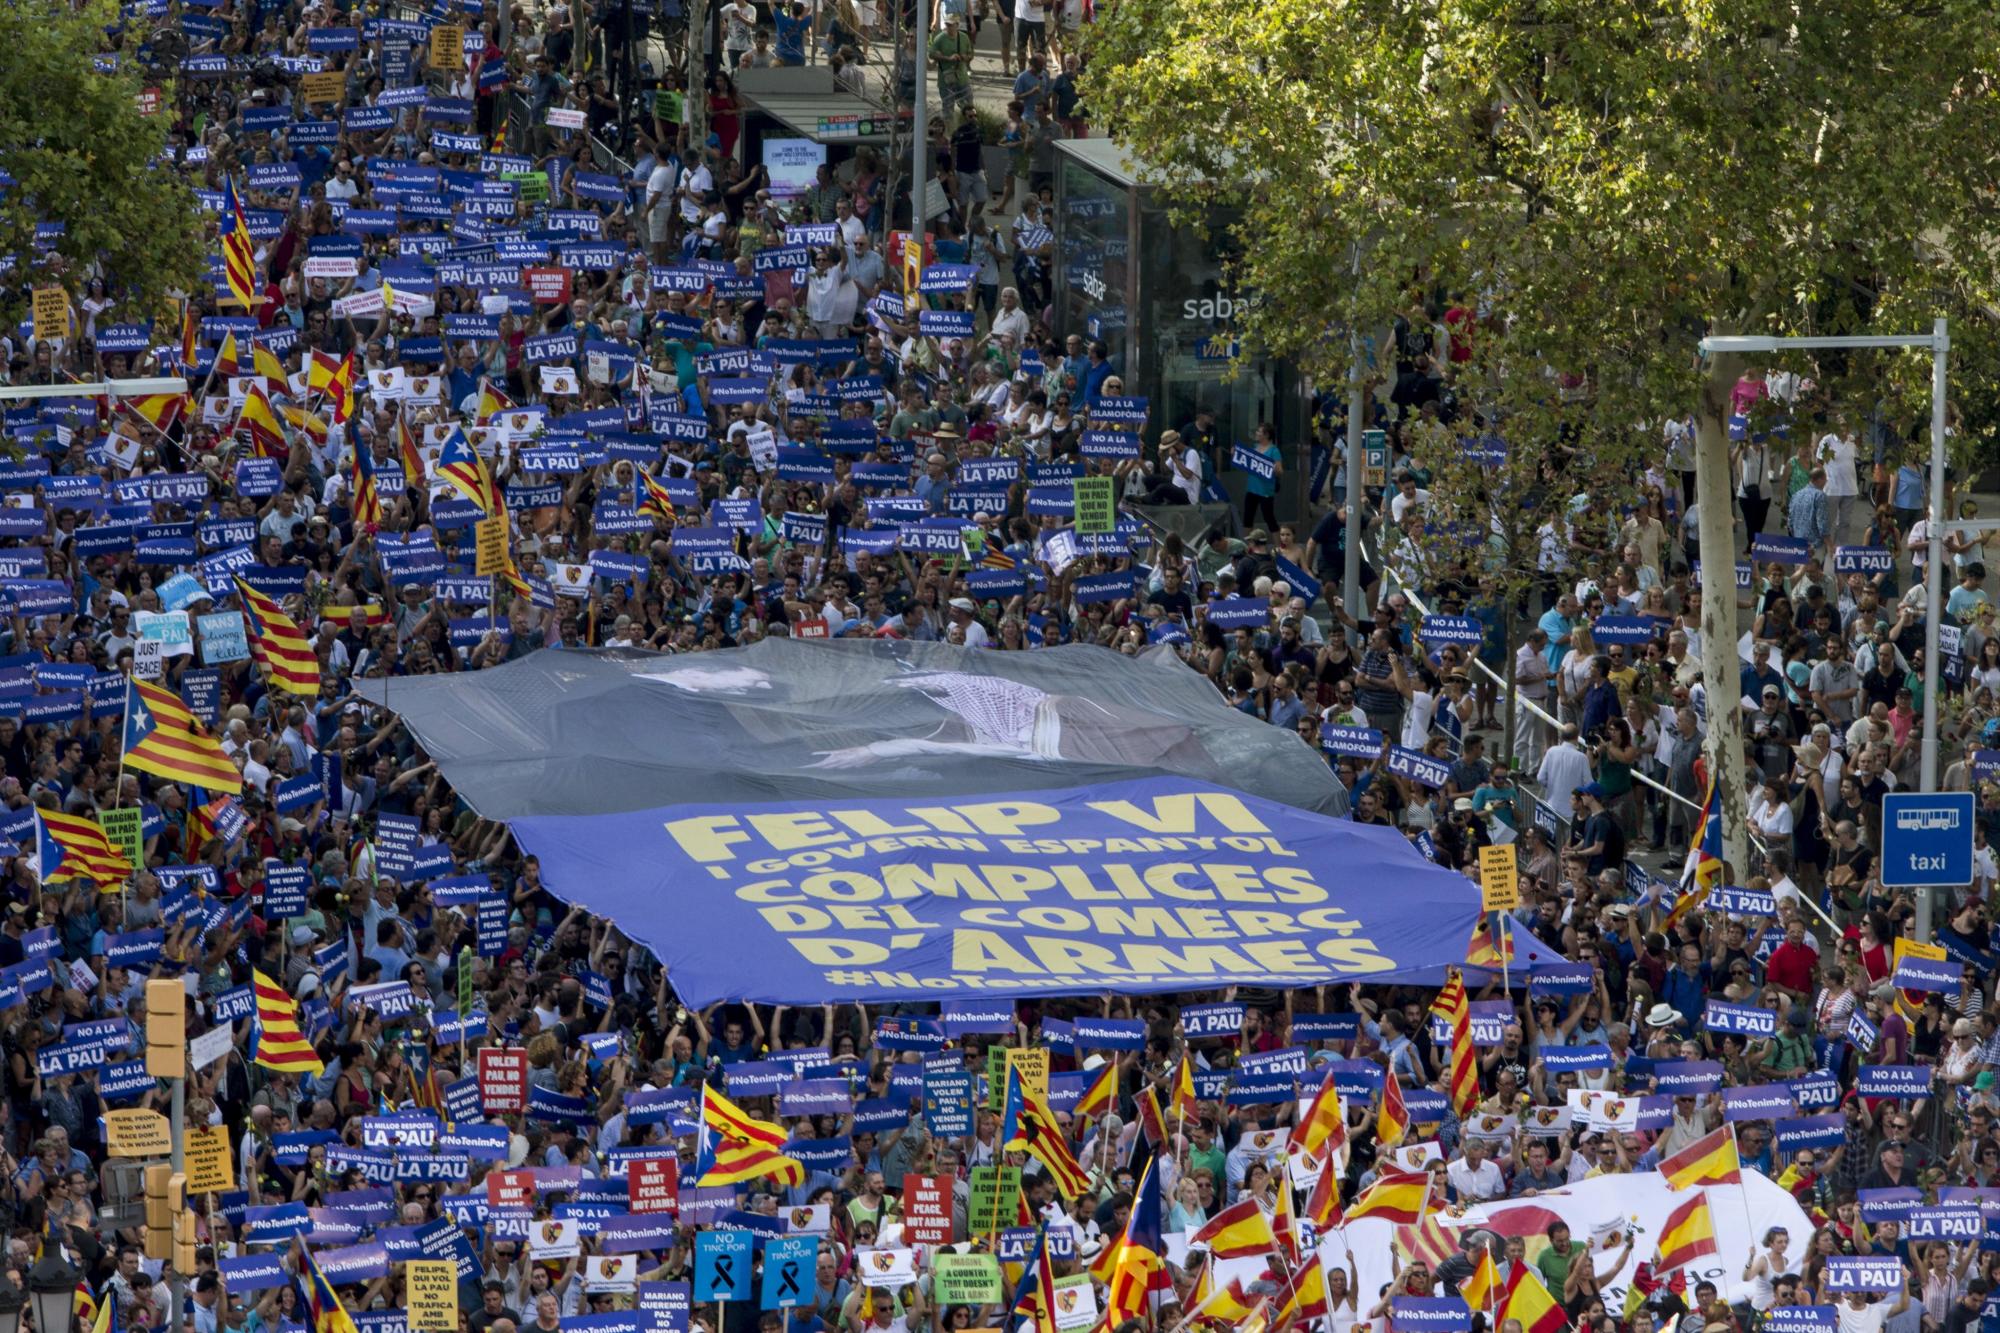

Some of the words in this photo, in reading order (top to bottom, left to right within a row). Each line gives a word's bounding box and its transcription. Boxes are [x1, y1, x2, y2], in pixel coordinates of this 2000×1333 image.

[576, 181, 624, 193] #NoTenimPor
[465, 202, 482, 214] LA
[486, 203, 514, 215] PAU
[1082, 269, 1105, 302] saba
[712, 387, 764, 395] #NoTenimPor
[1123, 400, 1134, 408] LA
[1370, 451, 1382, 466] P
[852, 471, 908, 481] #NoTenimPor
[963, 469, 983, 482] LA
[987, 467, 1018, 481] PAU
[1077, 481, 1110, 489] IMAGINA
[1082, 522, 1107, 530] ARMES
[139, 547, 193, 555] #NoTenimPor
[1834, 554, 1856, 569] LA
[1861, 556, 1892, 569] PAU
[1077, 582, 1131, 594] #NoTenimPor
[203, 615, 235, 630] VANS
[160, 627, 187, 643] PAU
[1595, 626, 1651, 634] #NoTenimPor
[138, 642, 160, 656] JUST
[134, 661, 161, 674] PEACE!
[103, 812, 138, 824] IMAGINA
[379, 819, 417, 832] MARIANO,
[663, 801, 1062, 863] FELIP
[1083, 792, 1273, 834] VI
[392, 832, 415, 841] WANT
[381, 840, 409, 851] PEACE,
[373, 849, 390, 860] NOT
[391, 853, 414, 862] ARMS
[704, 865, 732, 880] I
[744, 835, 990, 874] GOVERN
[999, 835, 1298, 858] ESPANYOL
[380, 861, 405, 871] SALES
[1909, 852, 1947, 871] taxi
[269, 866, 306, 875] MARIANO,
[282, 876, 304, 884] WANT
[734, 861, 1329, 904] CÒMPLICES
[273, 886, 299, 894] PEACE,
[283, 895, 305, 903] ARMS
[1710, 893, 1731, 909] LA
[1738, 896, 1775, 913] PAU
[273, 905, 297, 913] SALES
[756, 903, 941, 933] DEL
[959, 905, 1363, 940] COMERÇ
[107, 941, 160, 956] #NoTenimPor
[1532, 974, 1590, 984] #NoTenimPor
[1895, 966, 1958, 983] #NoTenimPor
[946, 1012, 1011, 1022] #NoTenimPor
[1707, 1011, 1730, 1028] LA
[1736, 1016, 1774, 1032] PAU
[1180, 1017, 1202, 1033] LA
[1207, 1014, 1243, 1031] PAU
[1077, 1028, 1141, 1039] #NoTenimPor
[487, 1056, 519, 1067] VOLEM
[1545, 1053, 1608, 1063] #NoTenimPor
[486, 1070, 505, 1081] PAU,
[507, 1071, 519, 1081] NO
[728, 1073, 794, 1085] #NoTenimPor
[1659, 1072, 1721, 1084] #NoTenimPor
[1872, 1071, 1889, 1079] NO
[1891, 1071, 1899, 1079] A
[1901, 1071, 1913, 1080] LA
[927, 1079, 969, 1088] MARIANO
[1228, 1083, 1293, 1094] #NoTenimPor
[484, 1084, 520, 1094] VENDRE
[933, 1088, 964, 1096] VOLEM
[939, 1097, 959, 1105] PAU,
[1727, 1097, 1790, 1109] #NoTenimPor
[932, 1114, 968, 1123] VENDRE
[935, 1123, 966, 1131] ARMES
[1779, 1126, 1845, 1141] #NoTenimPor
[191, 1139, 218, 1147] PEOPLE
[439, 1136, 506, 1148] #NoTenimPor
[204, 1146, 225, 1154] WANT
[784, 1149, 848, 1162] #NoTenimPor
[397, 1163, 421, 1177] LA
[428, 1162, 468, 1178] PAU
[646, 1162, 658, 1172] WE
[190, 1179, 227, 1189] WEAPONS
[640, 1174, 664, 1184] WANT
[921, 1178, 934, 1188] WE
[916, 1191, 940, 1201] WANT
[632, 1200, 649, 1210] NOT
[651, 1198, 676, 1208] ARMS
[907, 1217, 924, 1227] NOT
[926, 1217, 950, 1227] ARMS
[1910, 1219, 1935, 1236] LA
[1941, 1218, 1980, 1235] PAU
[606, 1227, 673, 1240] #NoTenimPor
[715, 1233, 734, 1244] NO
[915, 1230, 942, 1240] SALES
[704, 1244, 724, 1252] TINC
[726, 1241, 745, 1251] POR
[783, 1240, 801, 1250] NO
[792, 1247, 811, 1257] POR
[950, 1258, 982, 1266] IMAGINE
[1866, 1260, 1901, 1269] RESPOSTA
[226, 1266, 280, 1280] #NoTenimPor
[414, 1266, 449, 1274] FELIPE,
[946, 1270, 952, 1278] A
[942, 1279, 961, 1288] THAT
[963, 1279, 993, 1288] DOESN'T
[1829, 1270, 1854, 1286] LA
[1861, 1270, 1900, 1287] PAU
[644, 1292, 685, 1300] MARIANO
[948, 1290, 966, 1300] SELL
[967, 1290, 989, 1299] ARMS
[640, 1301, 688, 1309] QUEREMOS
[654, 1311, 673, 1319] PAZ,
[1396, 1309, 1466, 1320] #NoTenimPor
